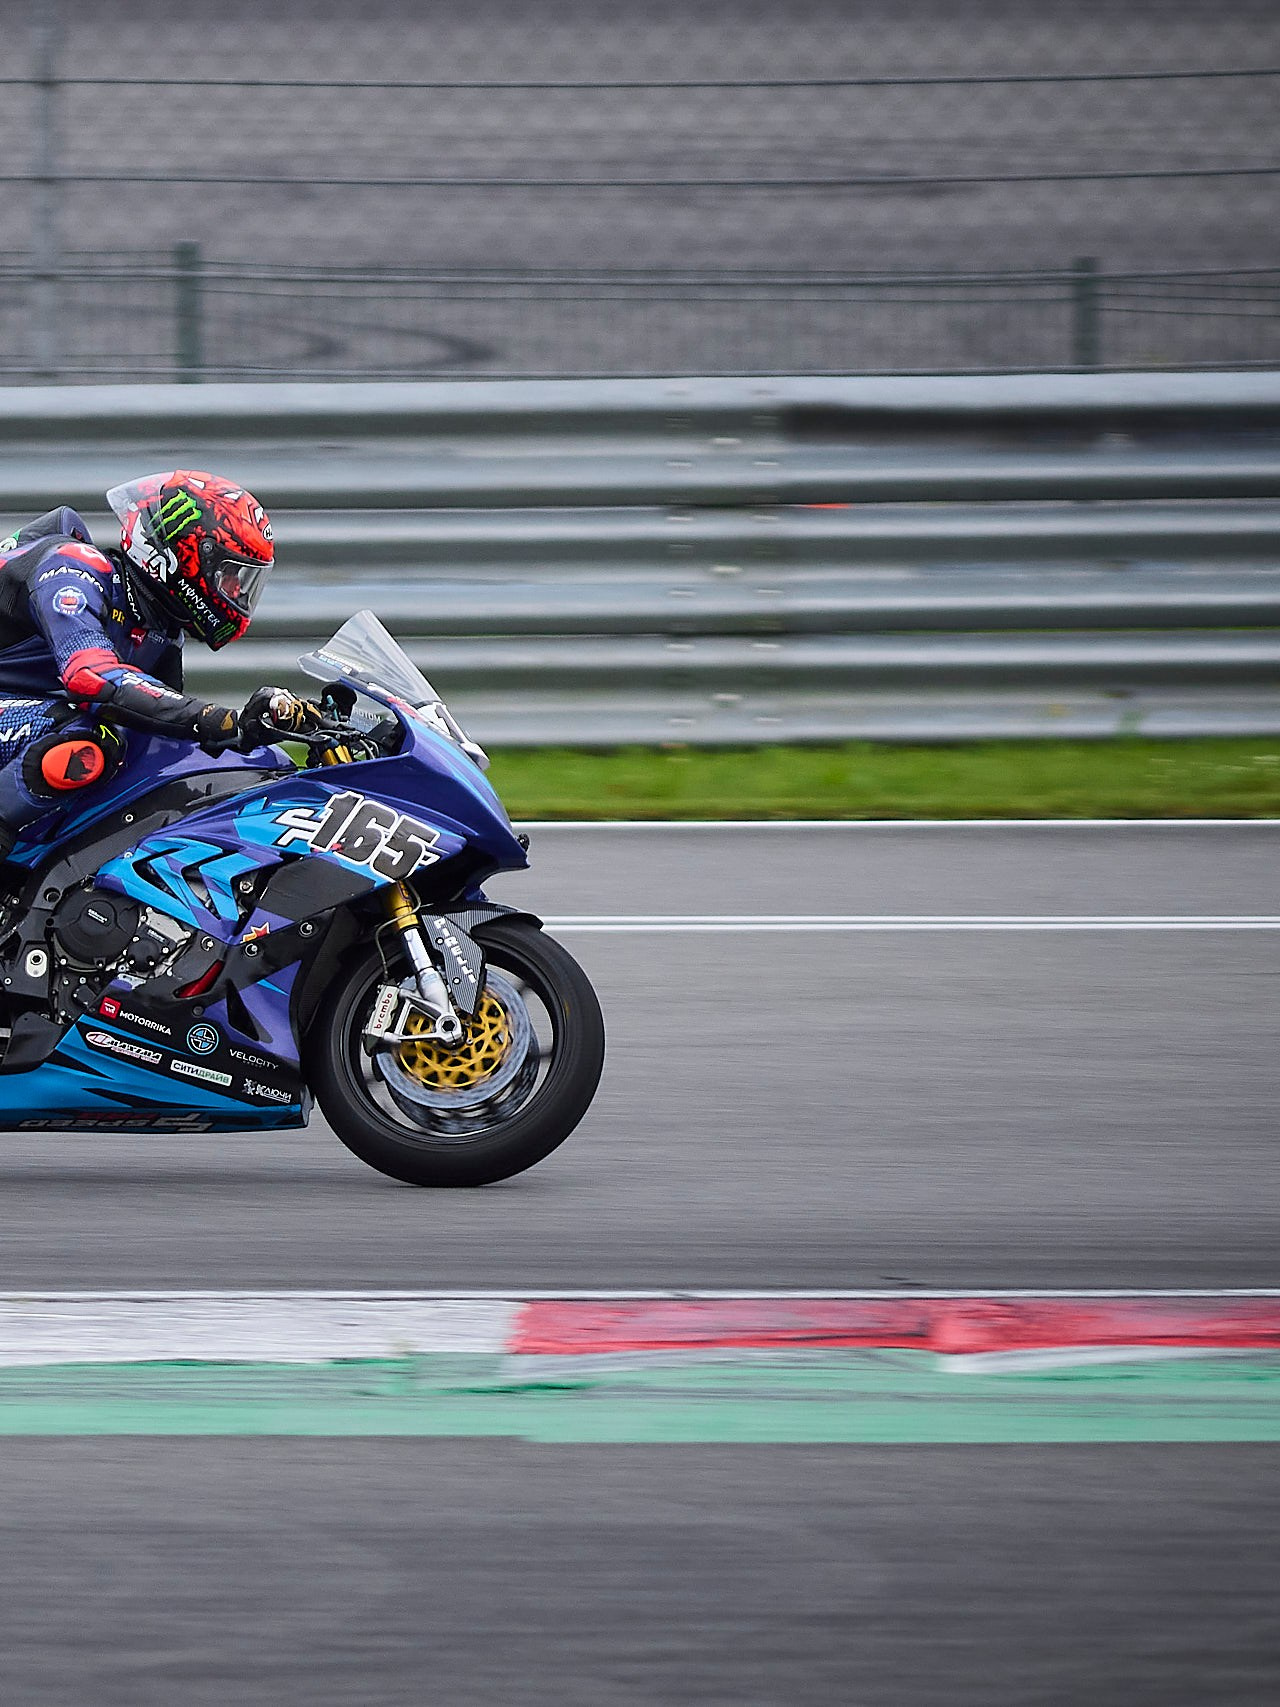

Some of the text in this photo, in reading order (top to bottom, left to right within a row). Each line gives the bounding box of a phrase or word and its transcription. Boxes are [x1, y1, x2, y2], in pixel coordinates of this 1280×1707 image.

[307, 790, 441, 883] 165
[433, 917, 477, 984] PIRELLI
[119, 1010, 172, 1036] MOTORRIKA
[373, 993, 393, 1029] brembo
[173, 1062, 230, 1084] СИТИДРАЙВ
[229, 1048, 279, 1070] VELOCITY
